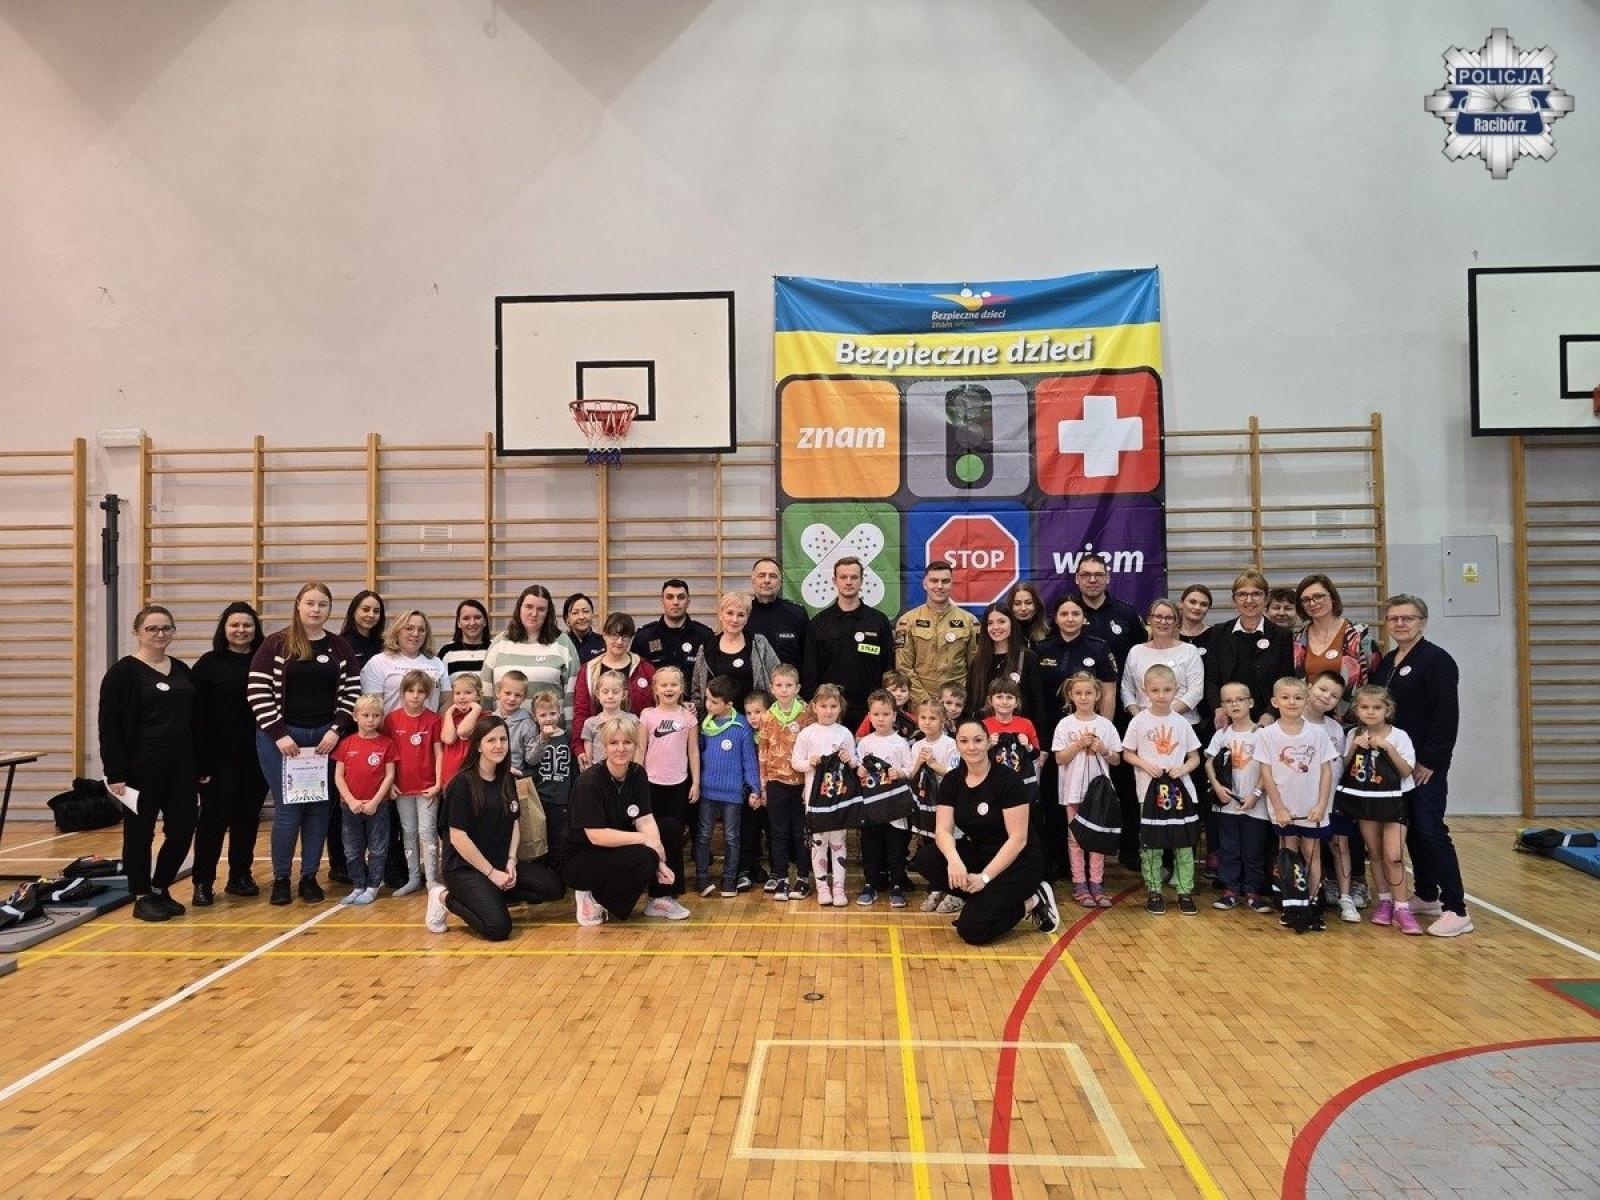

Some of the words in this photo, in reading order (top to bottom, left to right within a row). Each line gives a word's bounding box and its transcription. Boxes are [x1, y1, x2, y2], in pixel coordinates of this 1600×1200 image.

[931, 310, 979, 321] Bezpieczne
[980, 309, 1006, 319] dzieci
[931, 321, 953, 329] znam
[836, 339, 999, 369] Bezpieczne
[1007, 335, 1094, 362] dzieci
[796, 427, 886, 449] znam
[944, 550, 1005, 569] STOP
[659, 719, 679, 730] NIK
